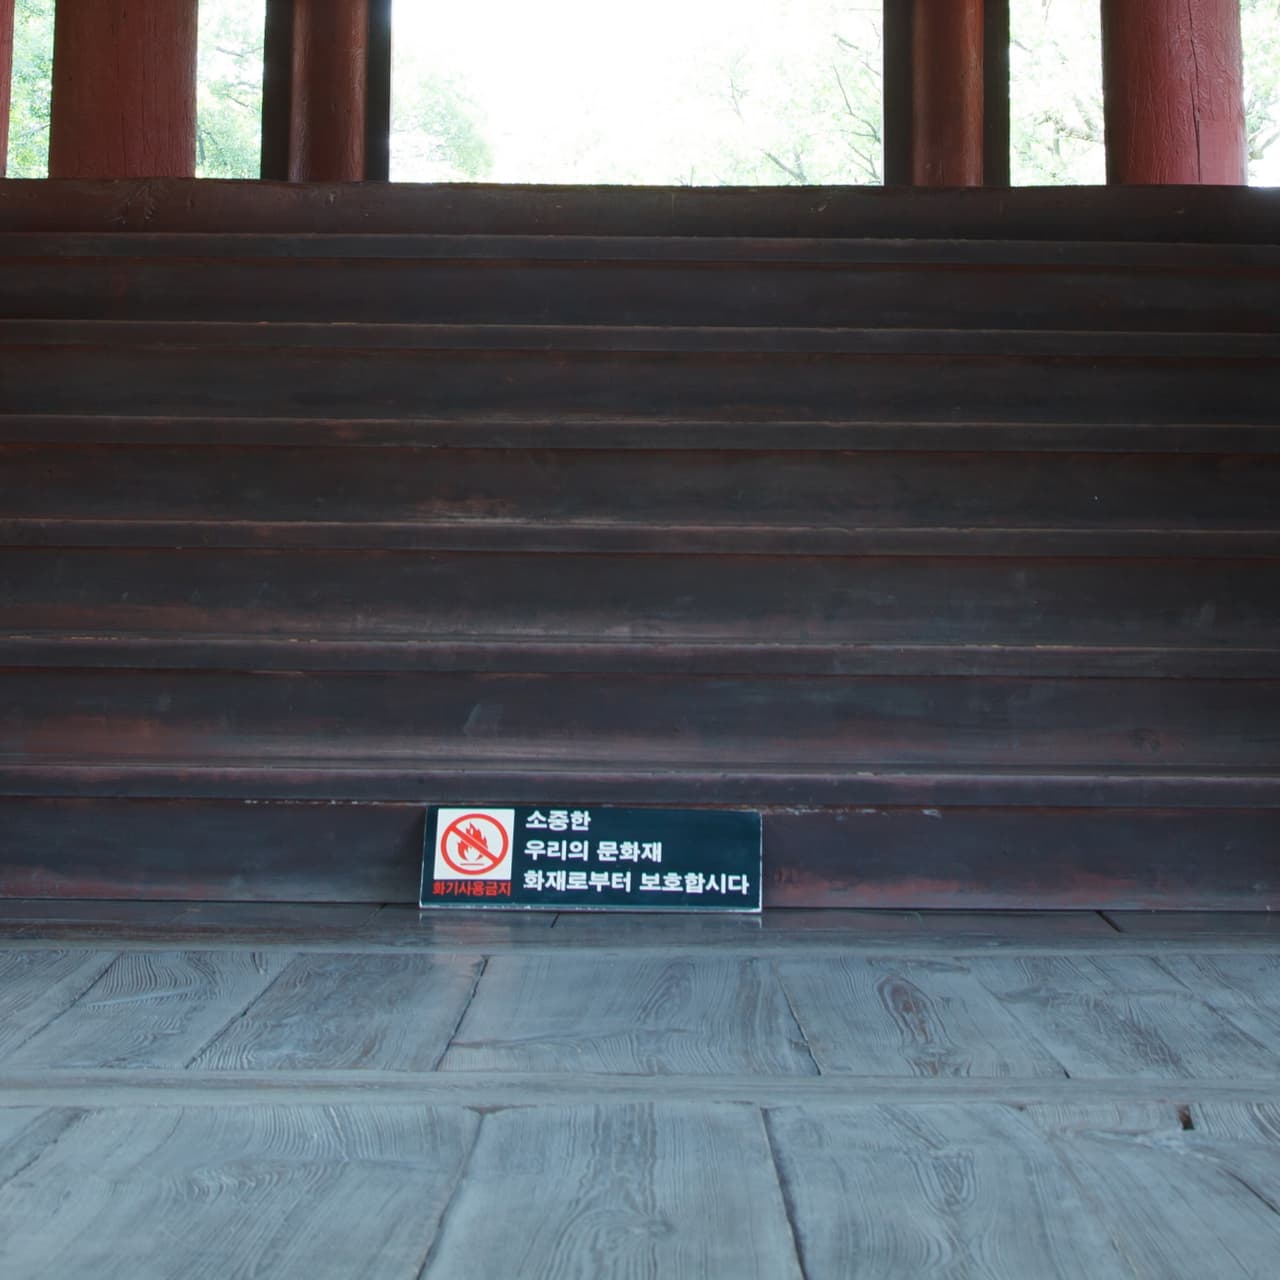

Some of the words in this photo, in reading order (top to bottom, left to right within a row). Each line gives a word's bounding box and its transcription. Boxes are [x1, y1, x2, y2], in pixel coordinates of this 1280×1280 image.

[525, 810, 591, 831] 소중한
[524, 839, 589, 862] 우리의
[596, 841, 662, 863] 문화재
[432, 880, 512, 896] 화기사용금지
[523, 870, 632, 892] 화재로부터
[639, 872, 750, 895] 보호합시다
